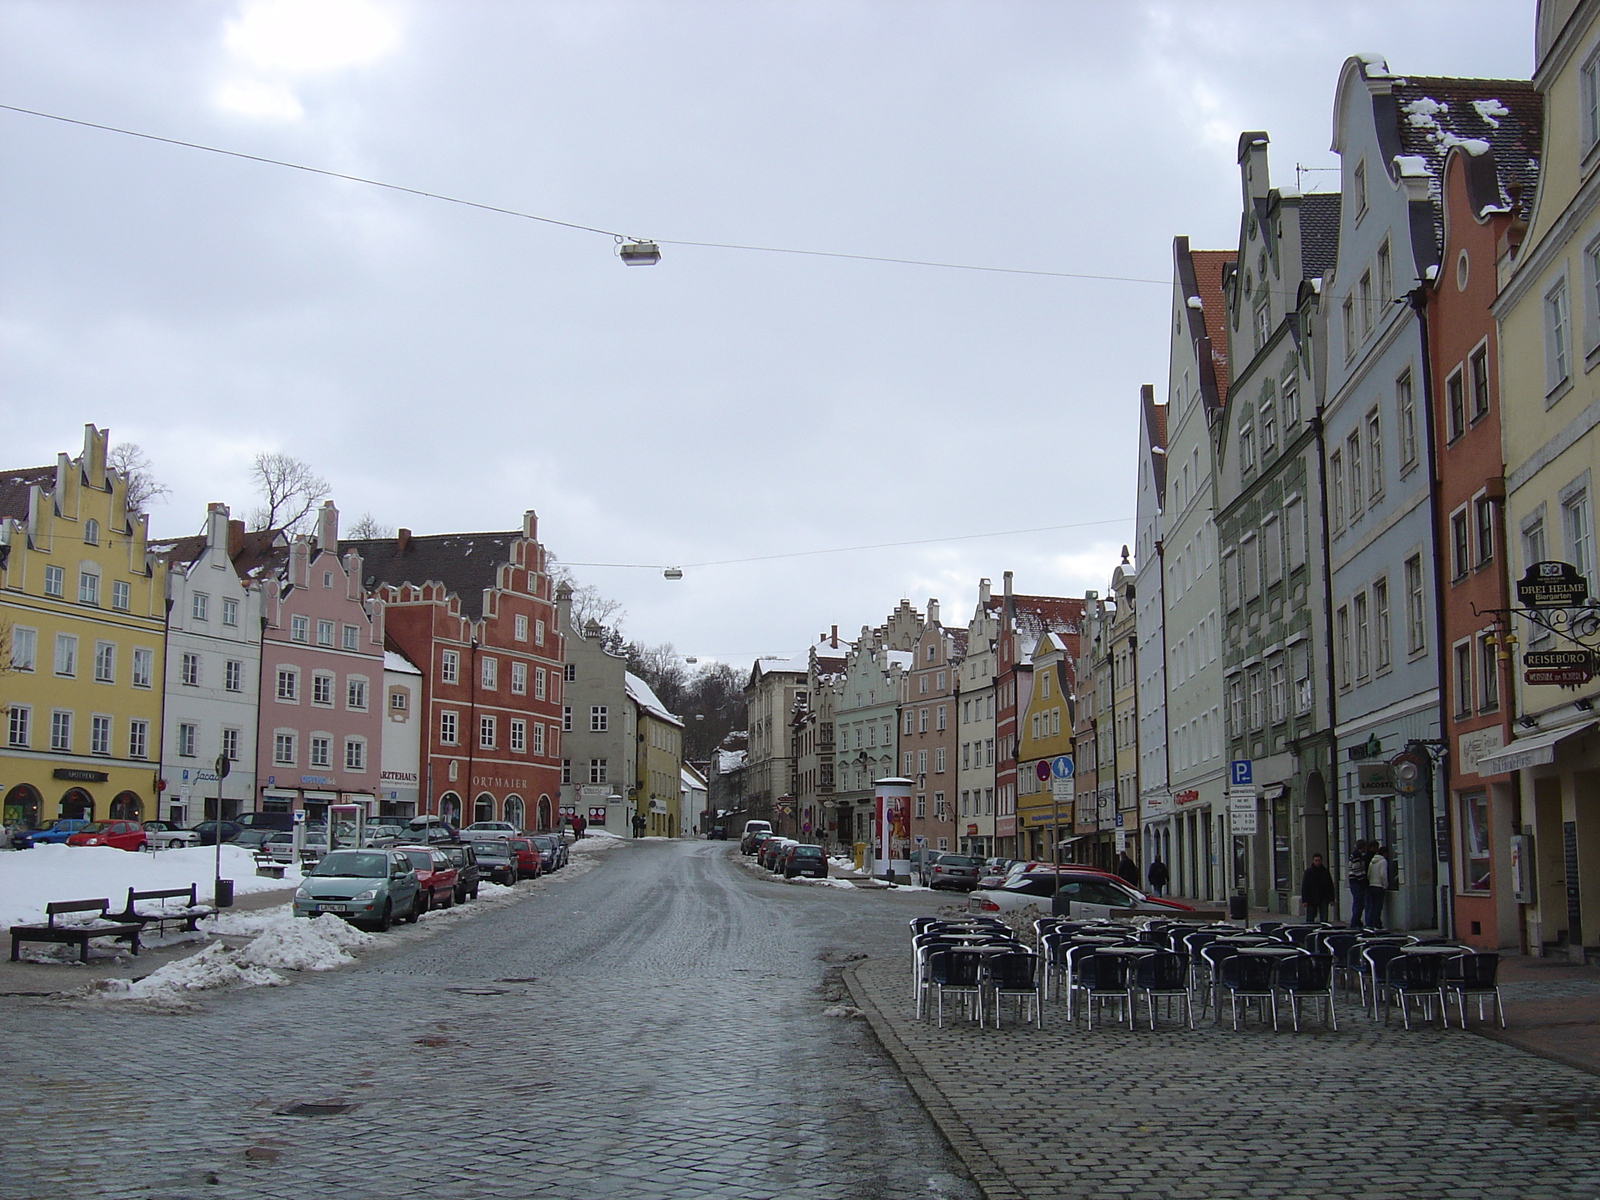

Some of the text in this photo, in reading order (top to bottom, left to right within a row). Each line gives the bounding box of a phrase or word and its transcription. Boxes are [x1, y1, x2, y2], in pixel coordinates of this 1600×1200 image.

[1521, 584, 1585, 594] DREI HELME
[1535, 593, 1572, 601] Biergarten
[1528, 653, 1586, 664] REISEBÜRO
[68, 771, 96, 779] APOTHEKE
[1236, 763, 1247, 781] P
[472, 776, 527, 788] ORTMAIER
